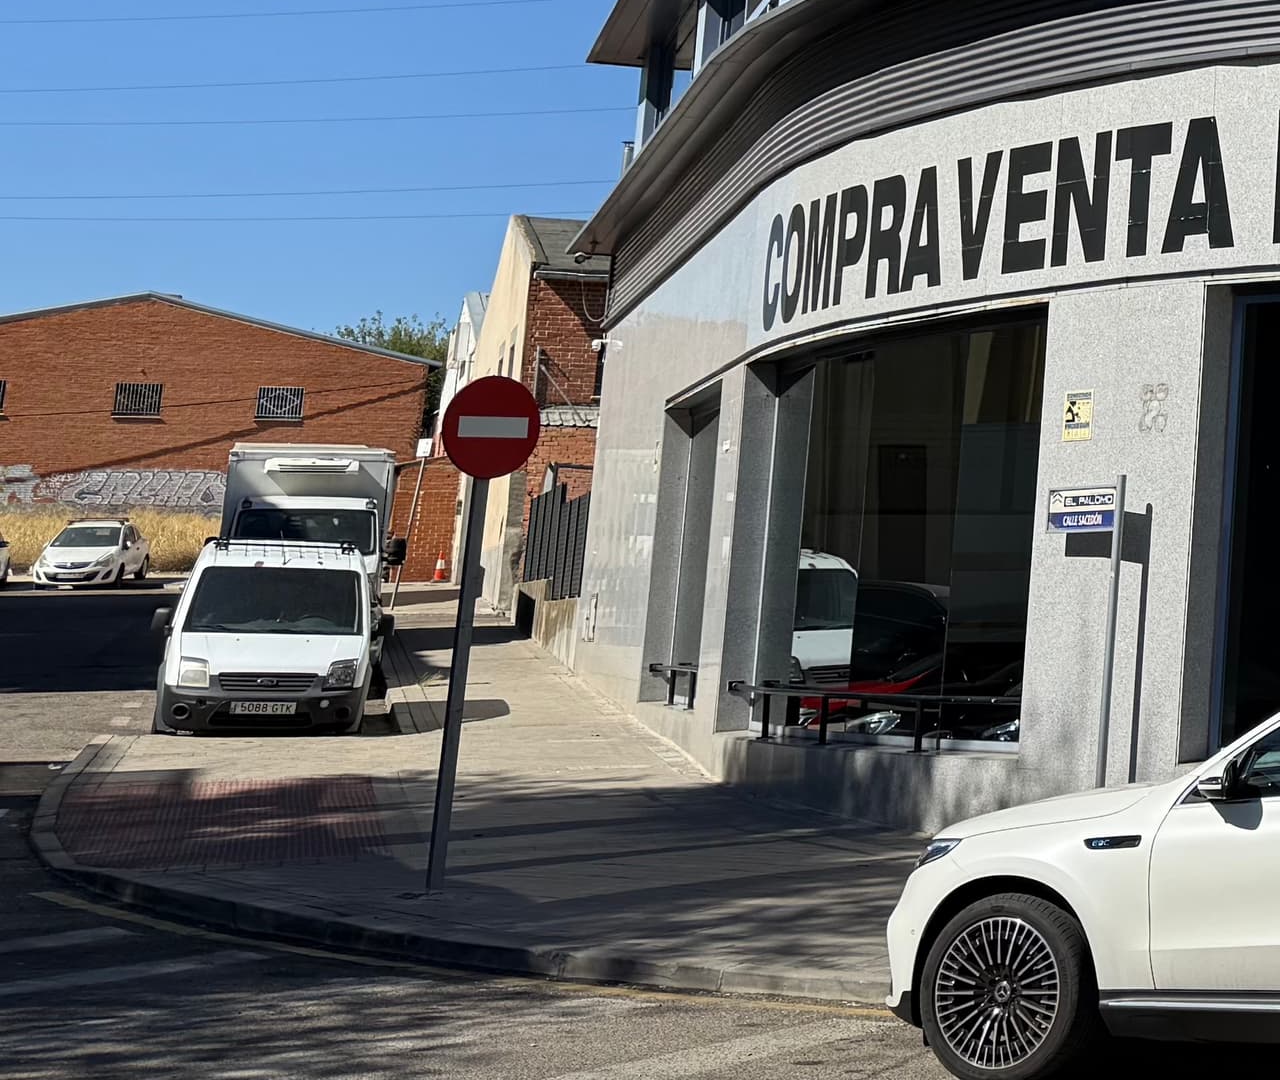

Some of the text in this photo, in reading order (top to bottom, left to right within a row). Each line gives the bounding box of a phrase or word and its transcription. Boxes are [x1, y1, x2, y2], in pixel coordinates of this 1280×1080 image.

[1065, 494, 1113, 506] EL PALOMO
[1063, 514, 1077, 526] CALLE
[240, 703, 292, 713] 5088 GTK
